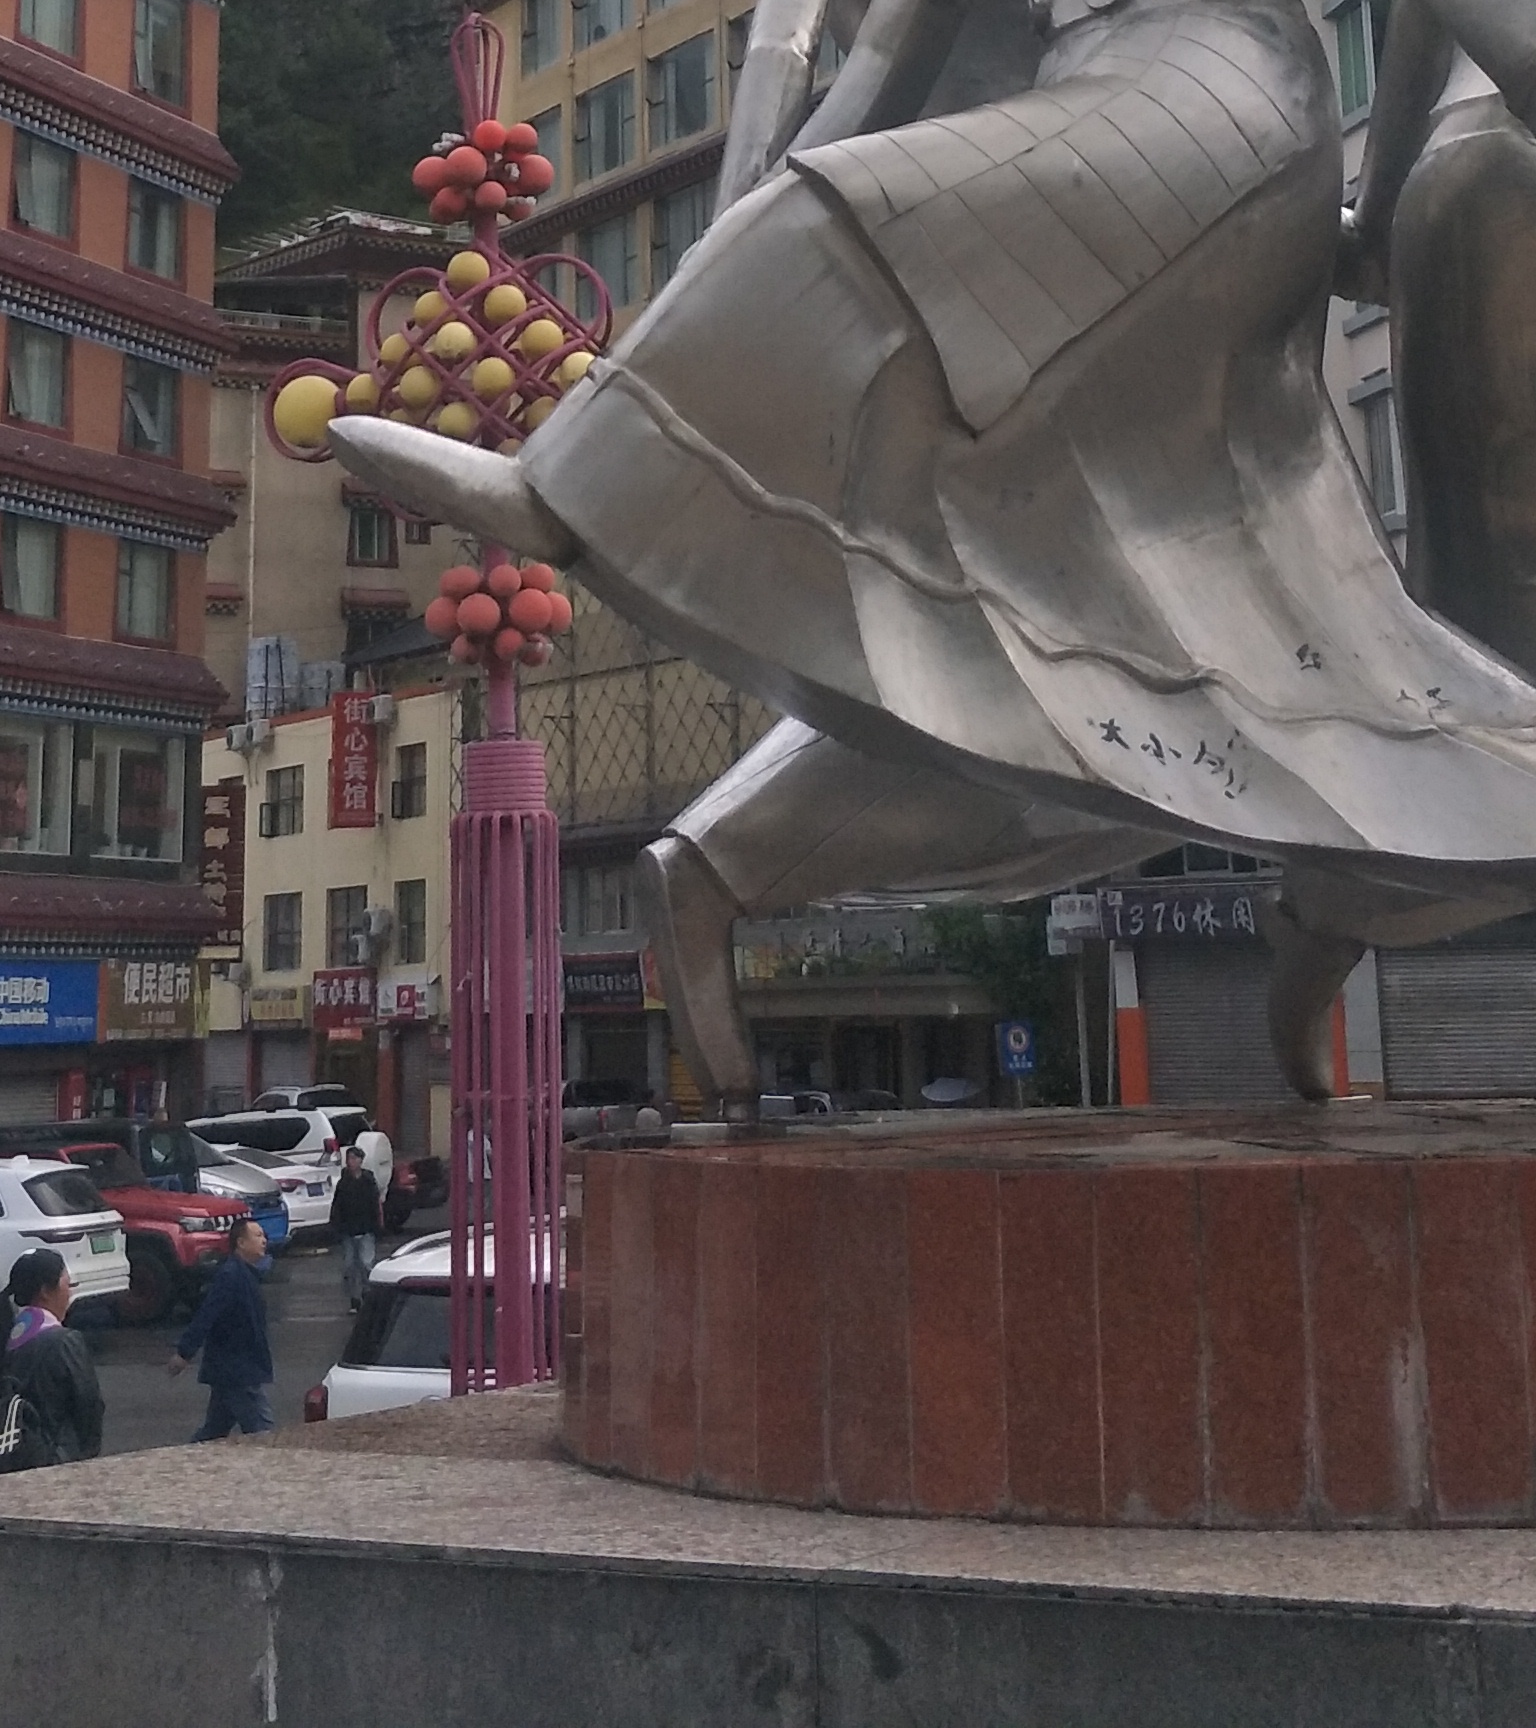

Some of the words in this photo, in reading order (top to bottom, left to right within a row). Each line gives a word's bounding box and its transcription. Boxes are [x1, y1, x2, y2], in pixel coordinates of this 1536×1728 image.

[342, 696, 370, 811] 街心宾馆
[123, 962, 192, 1005] 便民超市
